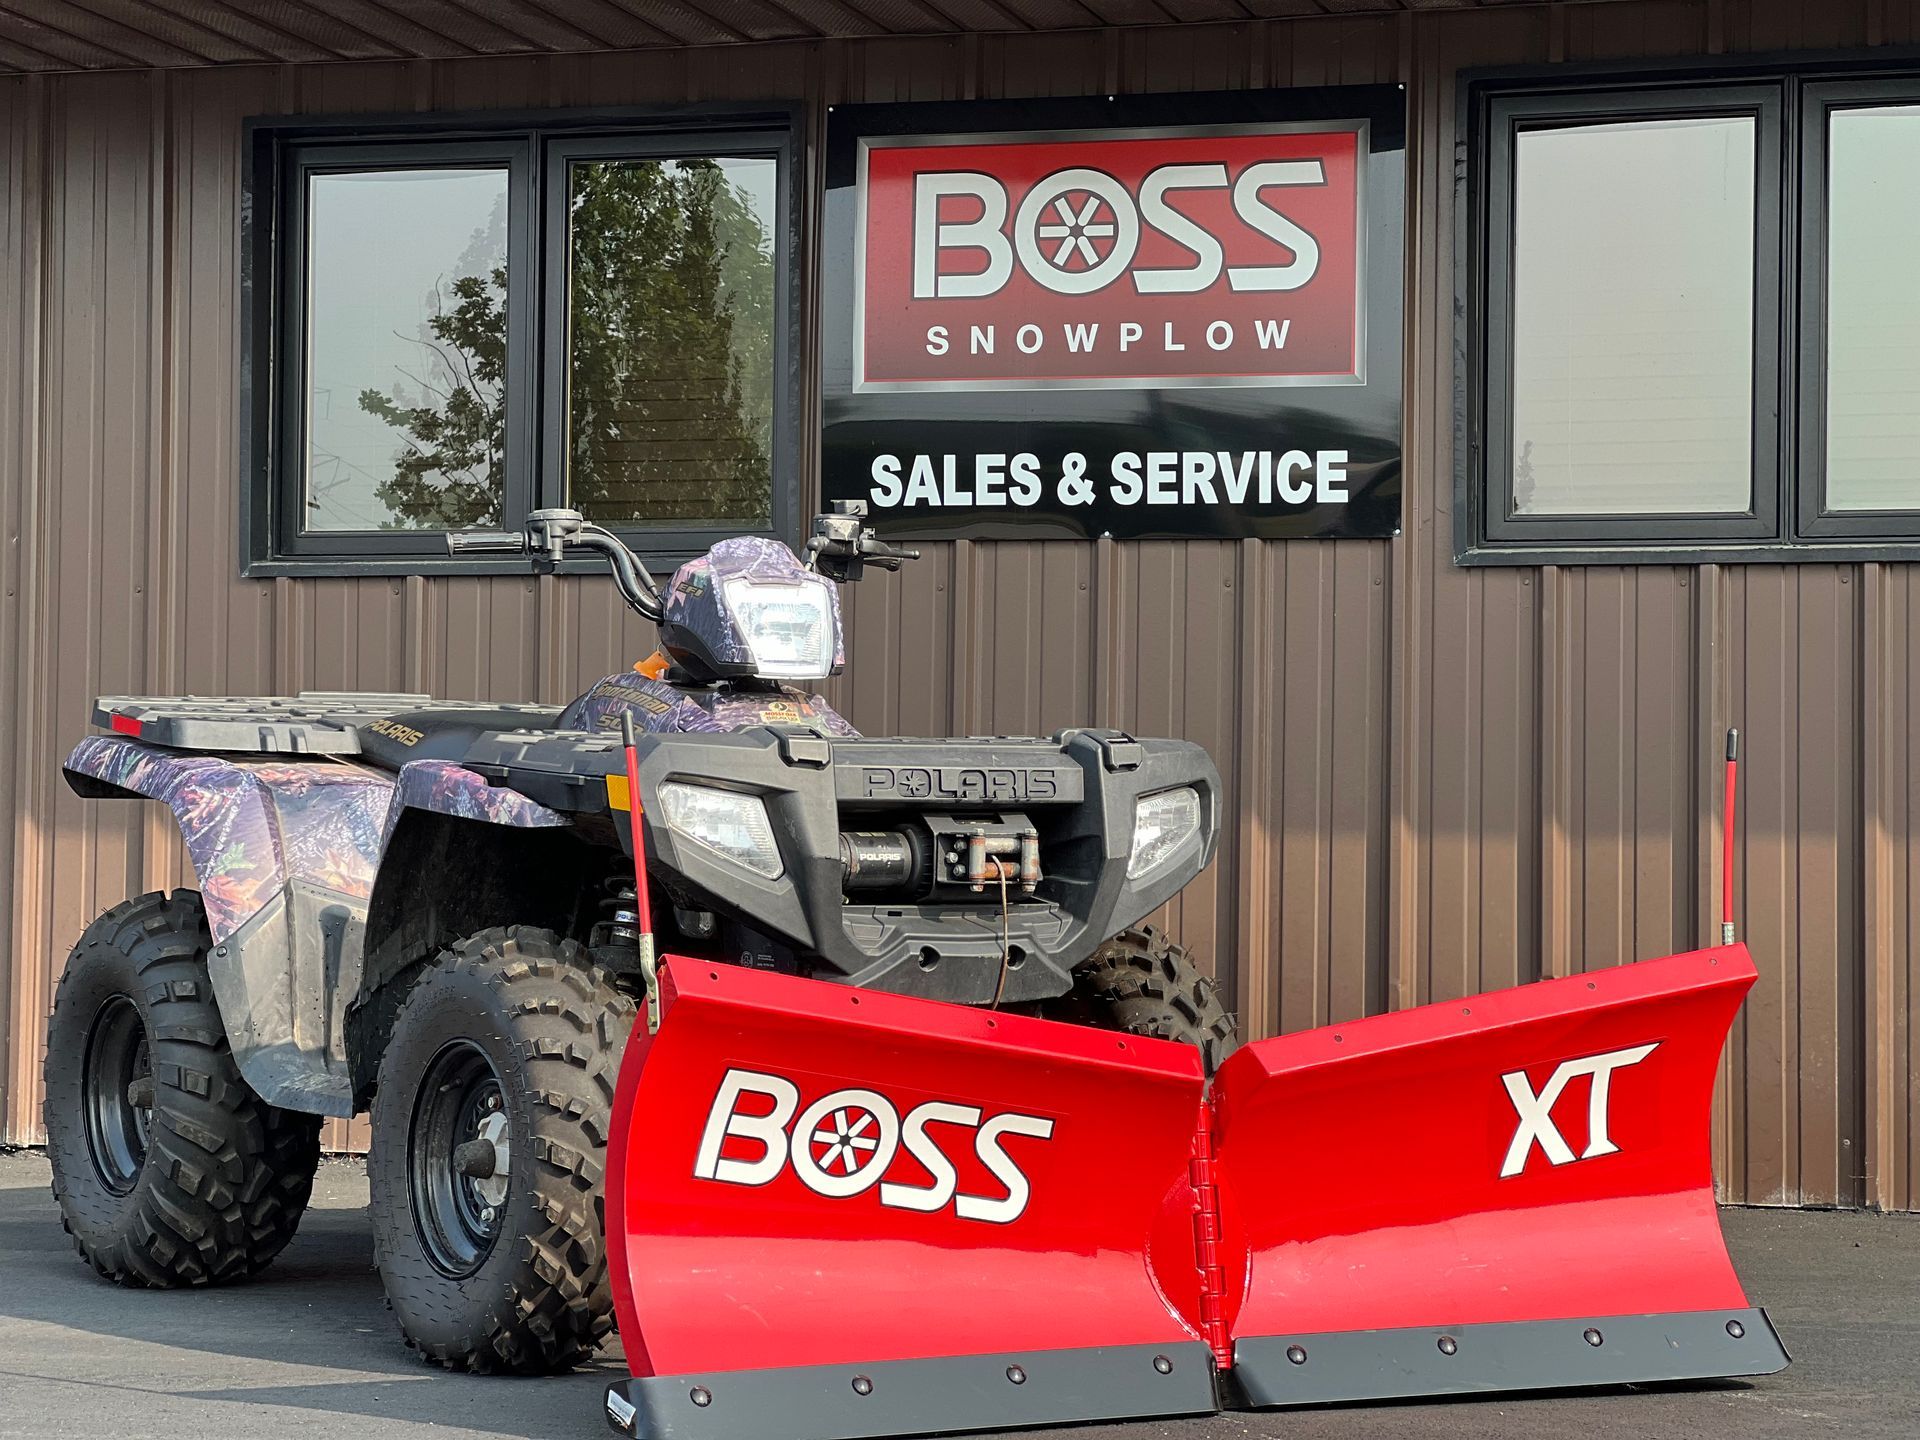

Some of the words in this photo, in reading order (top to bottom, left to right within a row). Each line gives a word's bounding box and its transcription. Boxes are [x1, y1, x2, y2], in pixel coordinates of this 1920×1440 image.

[913, 160, 1326, 298] BOSS
[925, 319, 1291, 356] SNOWPLOW
[869, 453, 1042, 507] SALES
[1056, 451, 1097, 506] &
[1109, 449, 1349, 505] SERVICE
[676, 582, 704, 598] EFI
[591, 681, 672, 715] Sportsman
[364, 719, 425, 747] POLARIS
[862, 767, 1057, 800] POLARIS
[859, 852, 902, 861] POLARIS
[1499, 1040, 1664, 1180] XT
[692, 1067, 1055, 1225] BOSS
